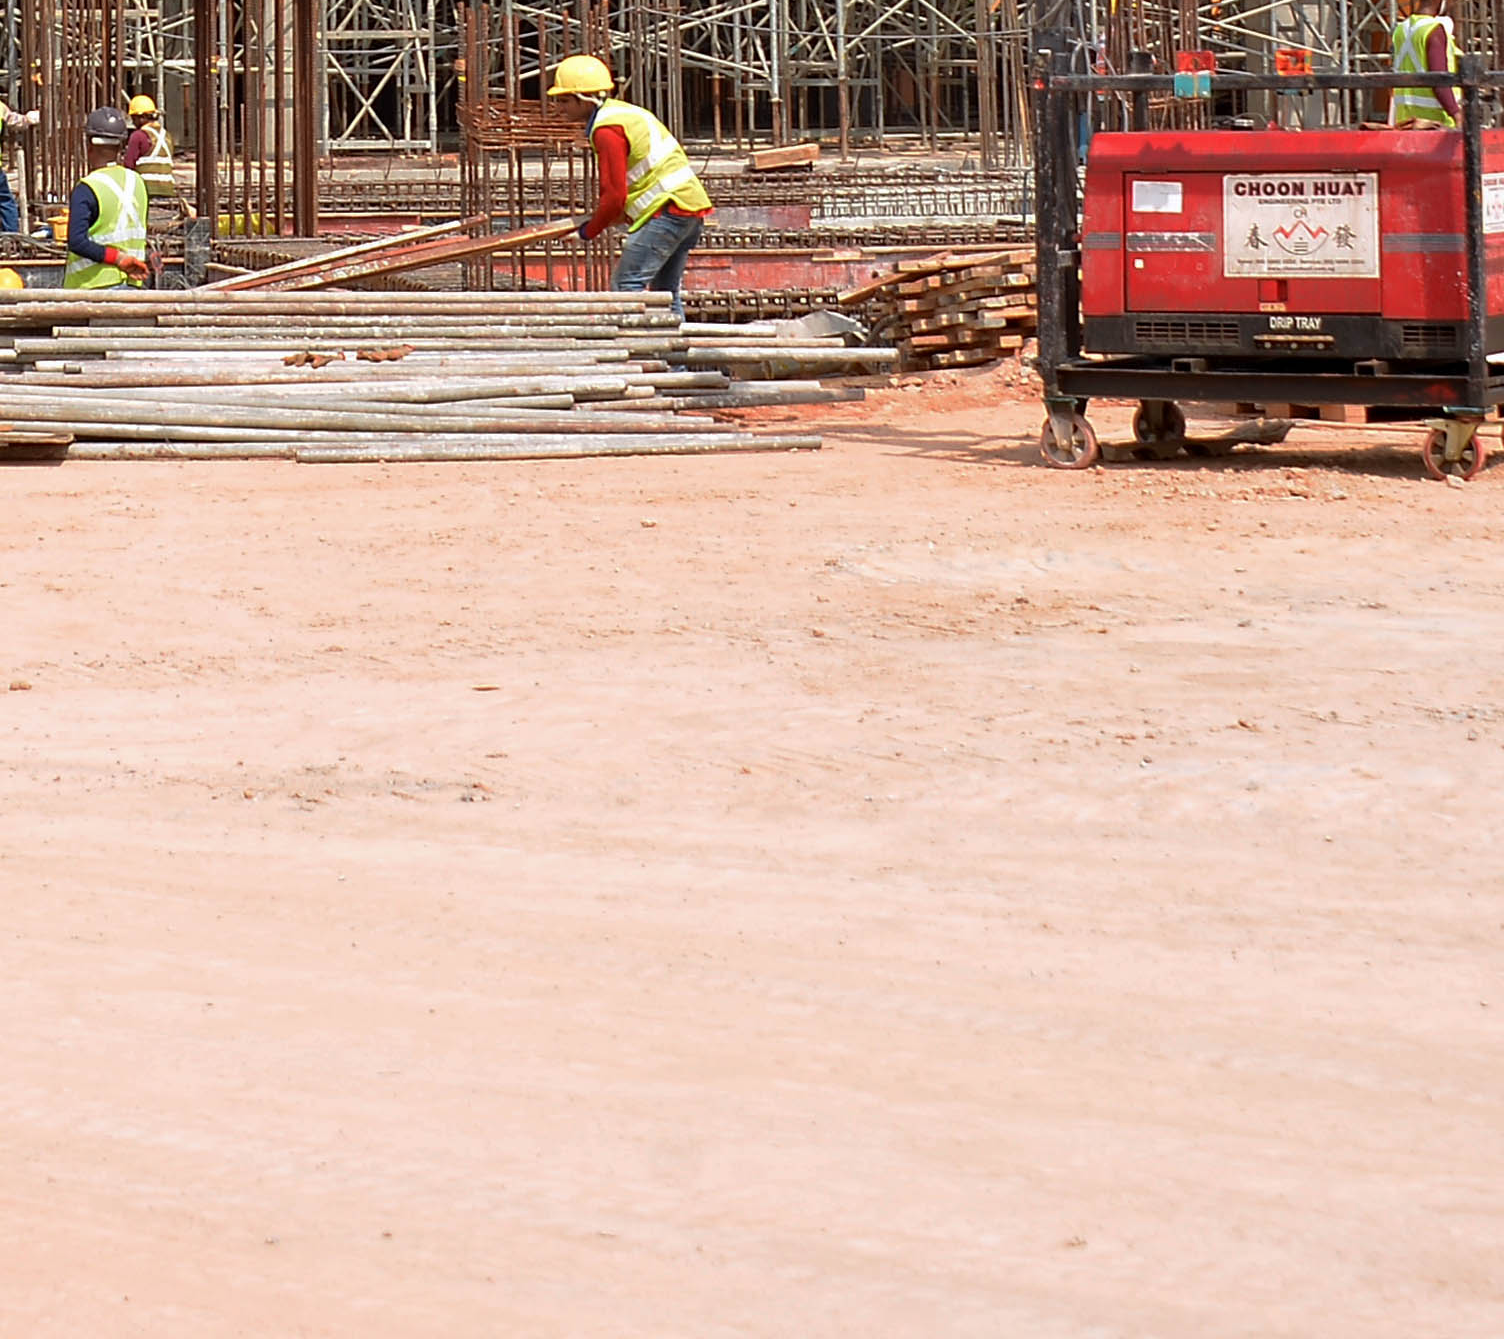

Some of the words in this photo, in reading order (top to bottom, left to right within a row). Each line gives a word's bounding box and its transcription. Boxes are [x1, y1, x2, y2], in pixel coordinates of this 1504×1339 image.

[1234, 181, 1305, 196] CHOON
[1313, 181, 1366, 196] HUAT
[1244, 223, 1269, 250] 春
[1269, 316, 1294, 329] DRIP
[1295, 316, 1321, 330] TRAY
